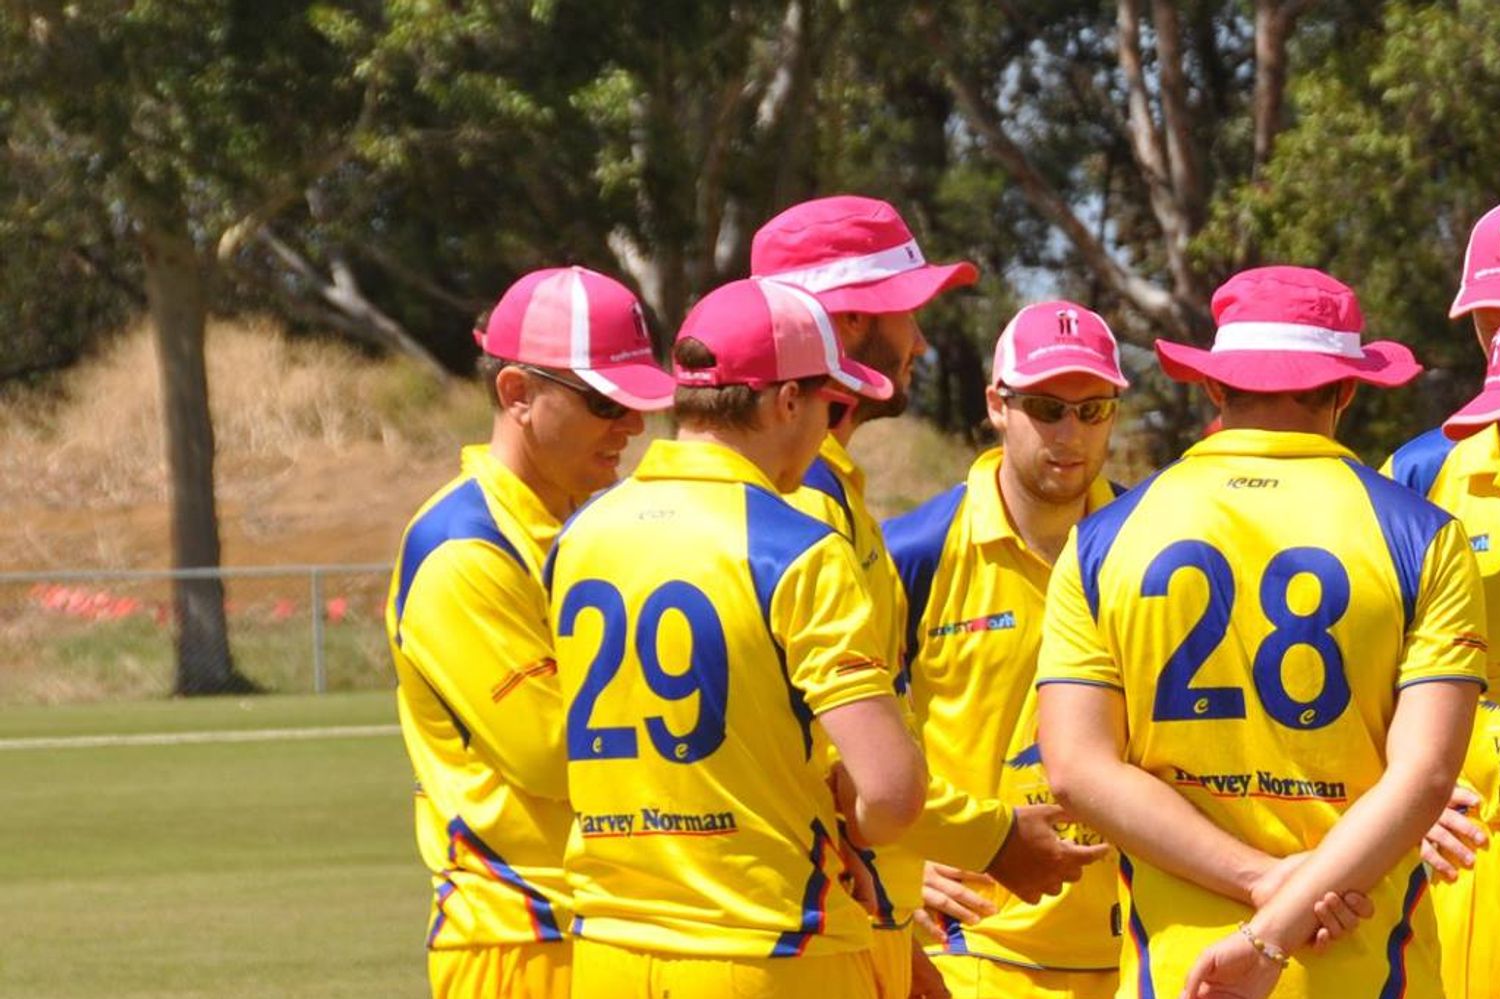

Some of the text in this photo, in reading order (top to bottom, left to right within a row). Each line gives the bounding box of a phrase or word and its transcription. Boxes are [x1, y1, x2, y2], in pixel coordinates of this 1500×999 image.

[558, 579, 730, 765] 29
[1140, 538, 1352, 731] 28
[574, 808, 738, 838] arvey Norman
[1257, 771, 1345, 798] Norman
